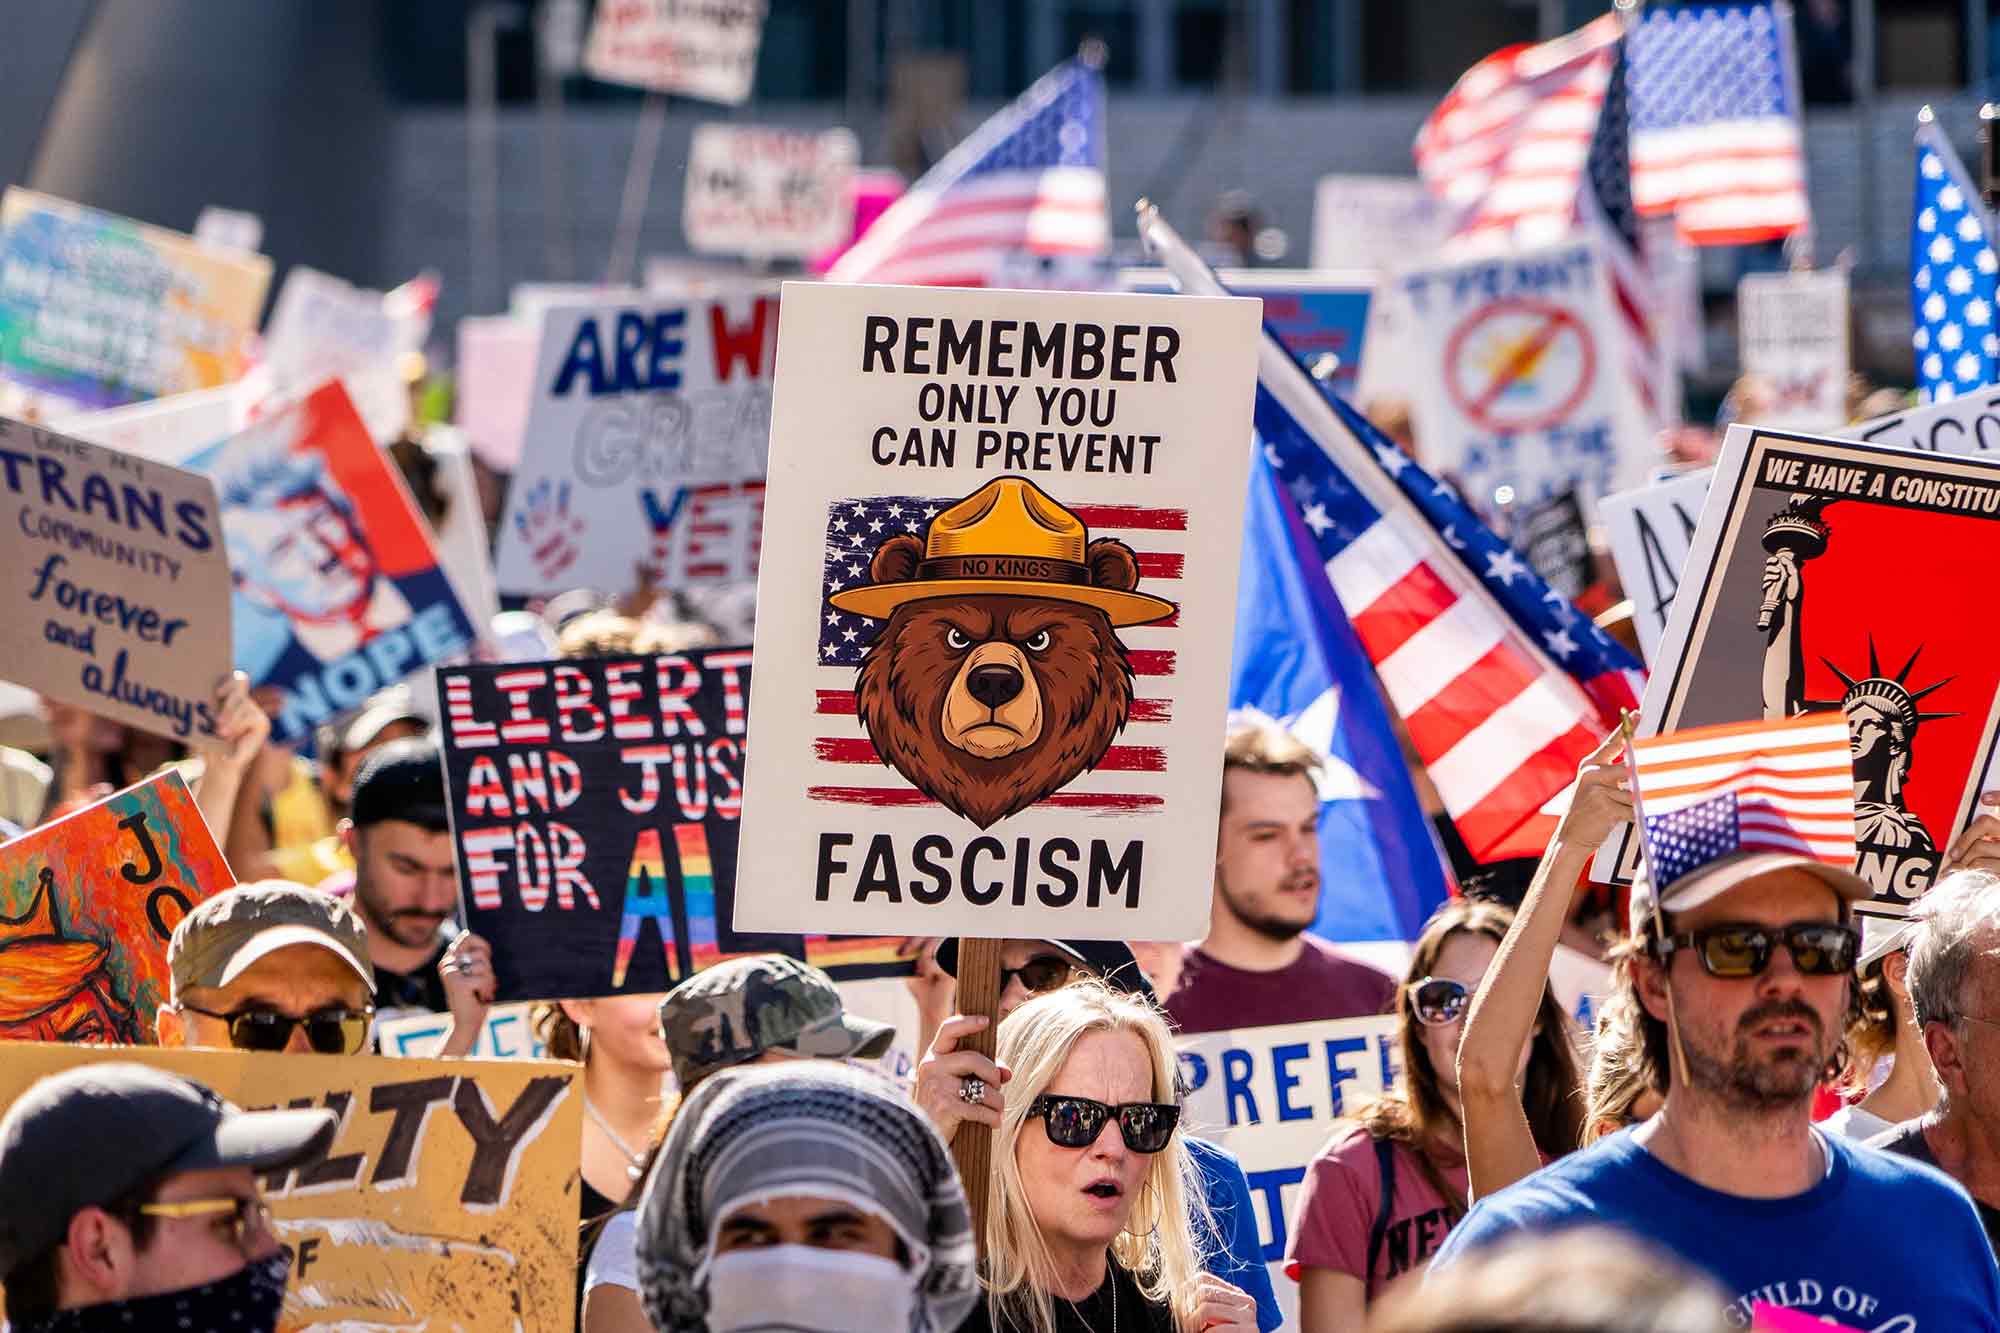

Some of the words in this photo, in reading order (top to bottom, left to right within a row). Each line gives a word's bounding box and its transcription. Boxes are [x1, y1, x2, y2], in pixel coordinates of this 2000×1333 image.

[552, 308, 687, 396] ARE
[708, 295, 781, 383] W
[862, 316, 1181, 383] REMEMBER
[918, 383, 1020, 425] ONLY
[1036, 386, 1117, 427] YOU
[872, 427, 957, 469] CAN
[976, 430, 1161, 475] PREVENT
[1764, 457, 1804, 485] WE
[1805, 464, 1867, 494] HAVE
[1867, 473, 1886, 498] A
[1890, 475, 2000, 513] CONSTITU
[0, 449, 212, 551] TRANS
[29, 553, 188, 649] forever
[962, 559, 989, 575] NO
[995, 559, 1050, 578] KINGS
[44, 620, 95, 657] and
[279, 604, 467, 740] NOPE
[80, 648, 216, 738] always
[466, 750, 583, 818] AND
[618, 736, 748, 820] JUS
[462, 820, 601, 913] FOR
[815, 832, 1145, 909] FASCISM
[1832, 1285, 1879, 1318] OF
